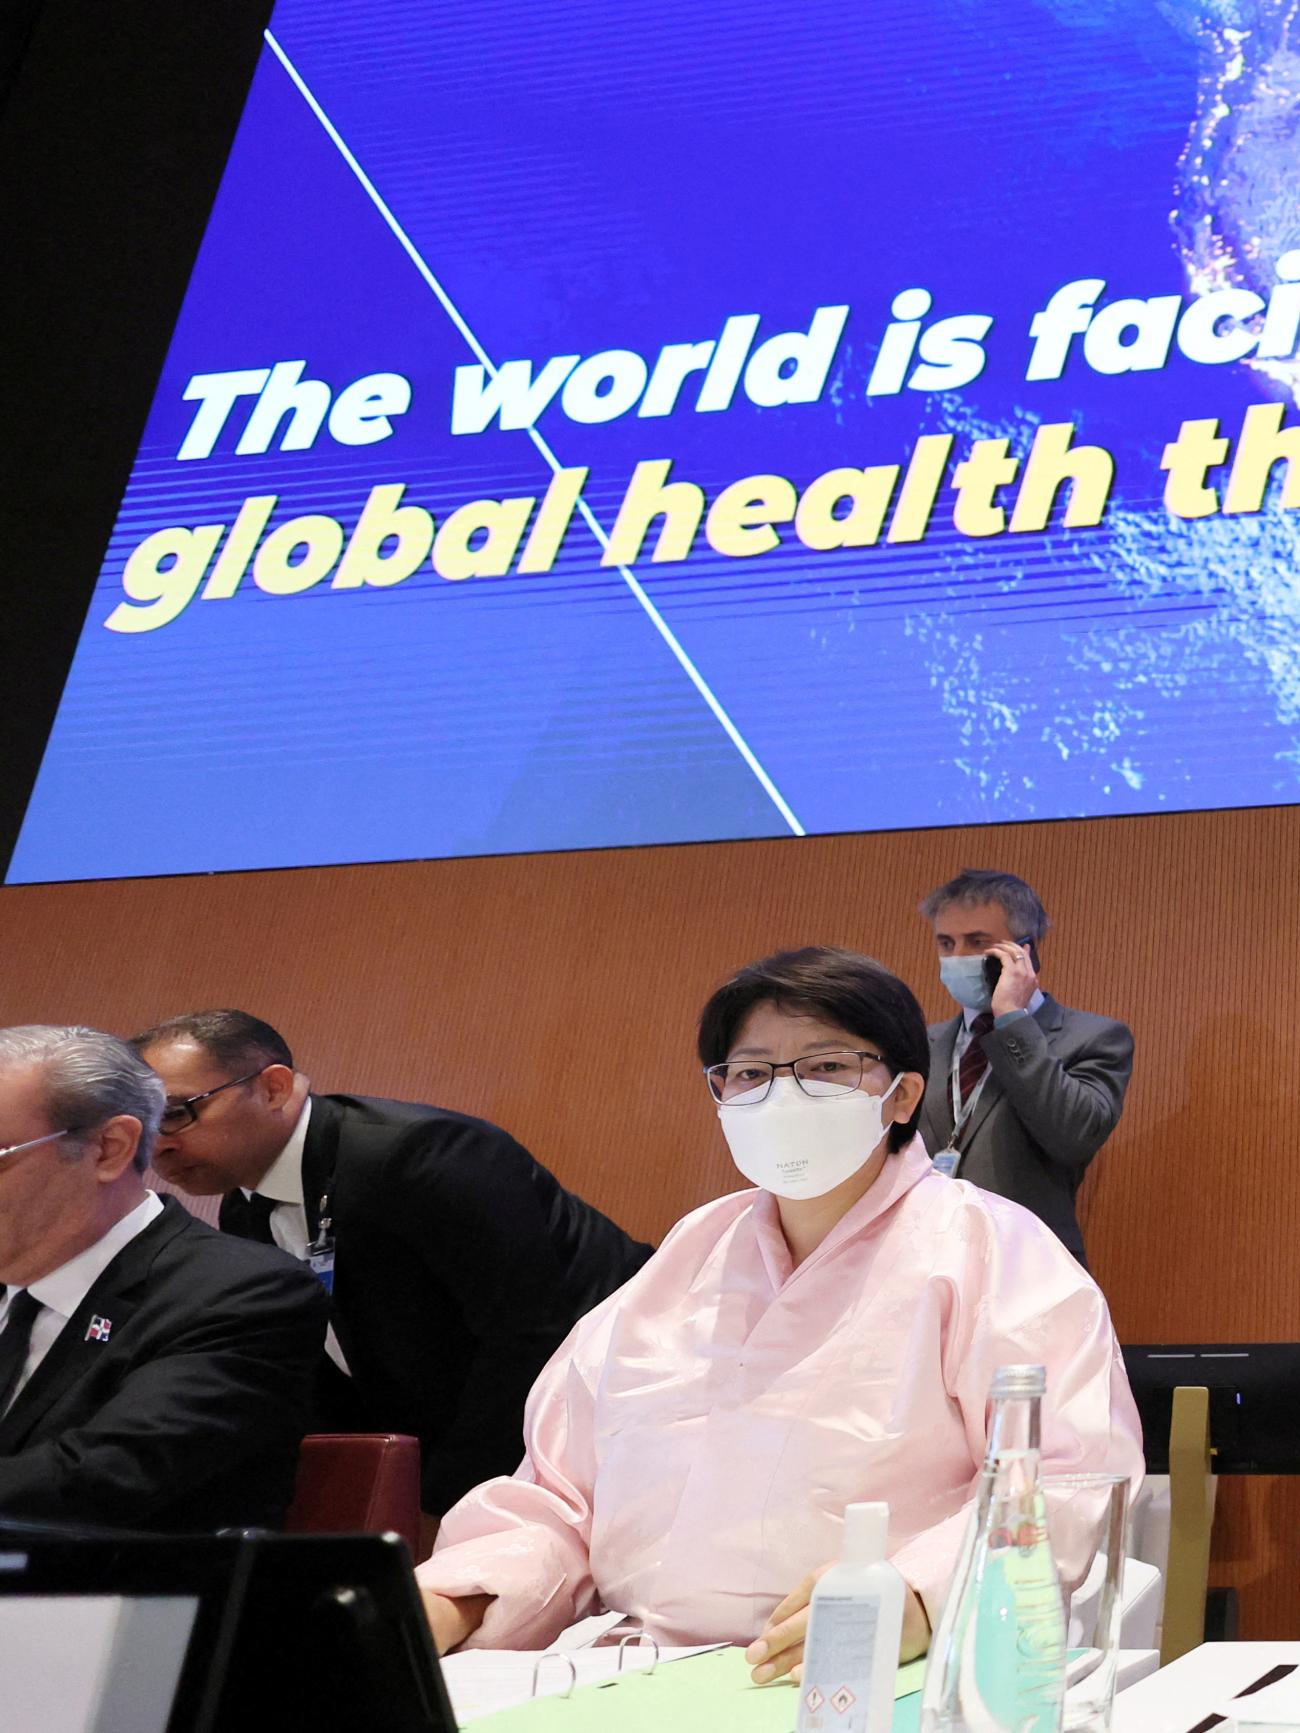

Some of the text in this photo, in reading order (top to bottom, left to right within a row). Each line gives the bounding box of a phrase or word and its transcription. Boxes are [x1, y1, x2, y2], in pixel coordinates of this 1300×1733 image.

[177, 360, 411, 461] The
[449, 304, 848, 436] world
[866, 288, 994, 397] is
[104, 466, 588, 634] global
[604, 423, 1115, 567] health
